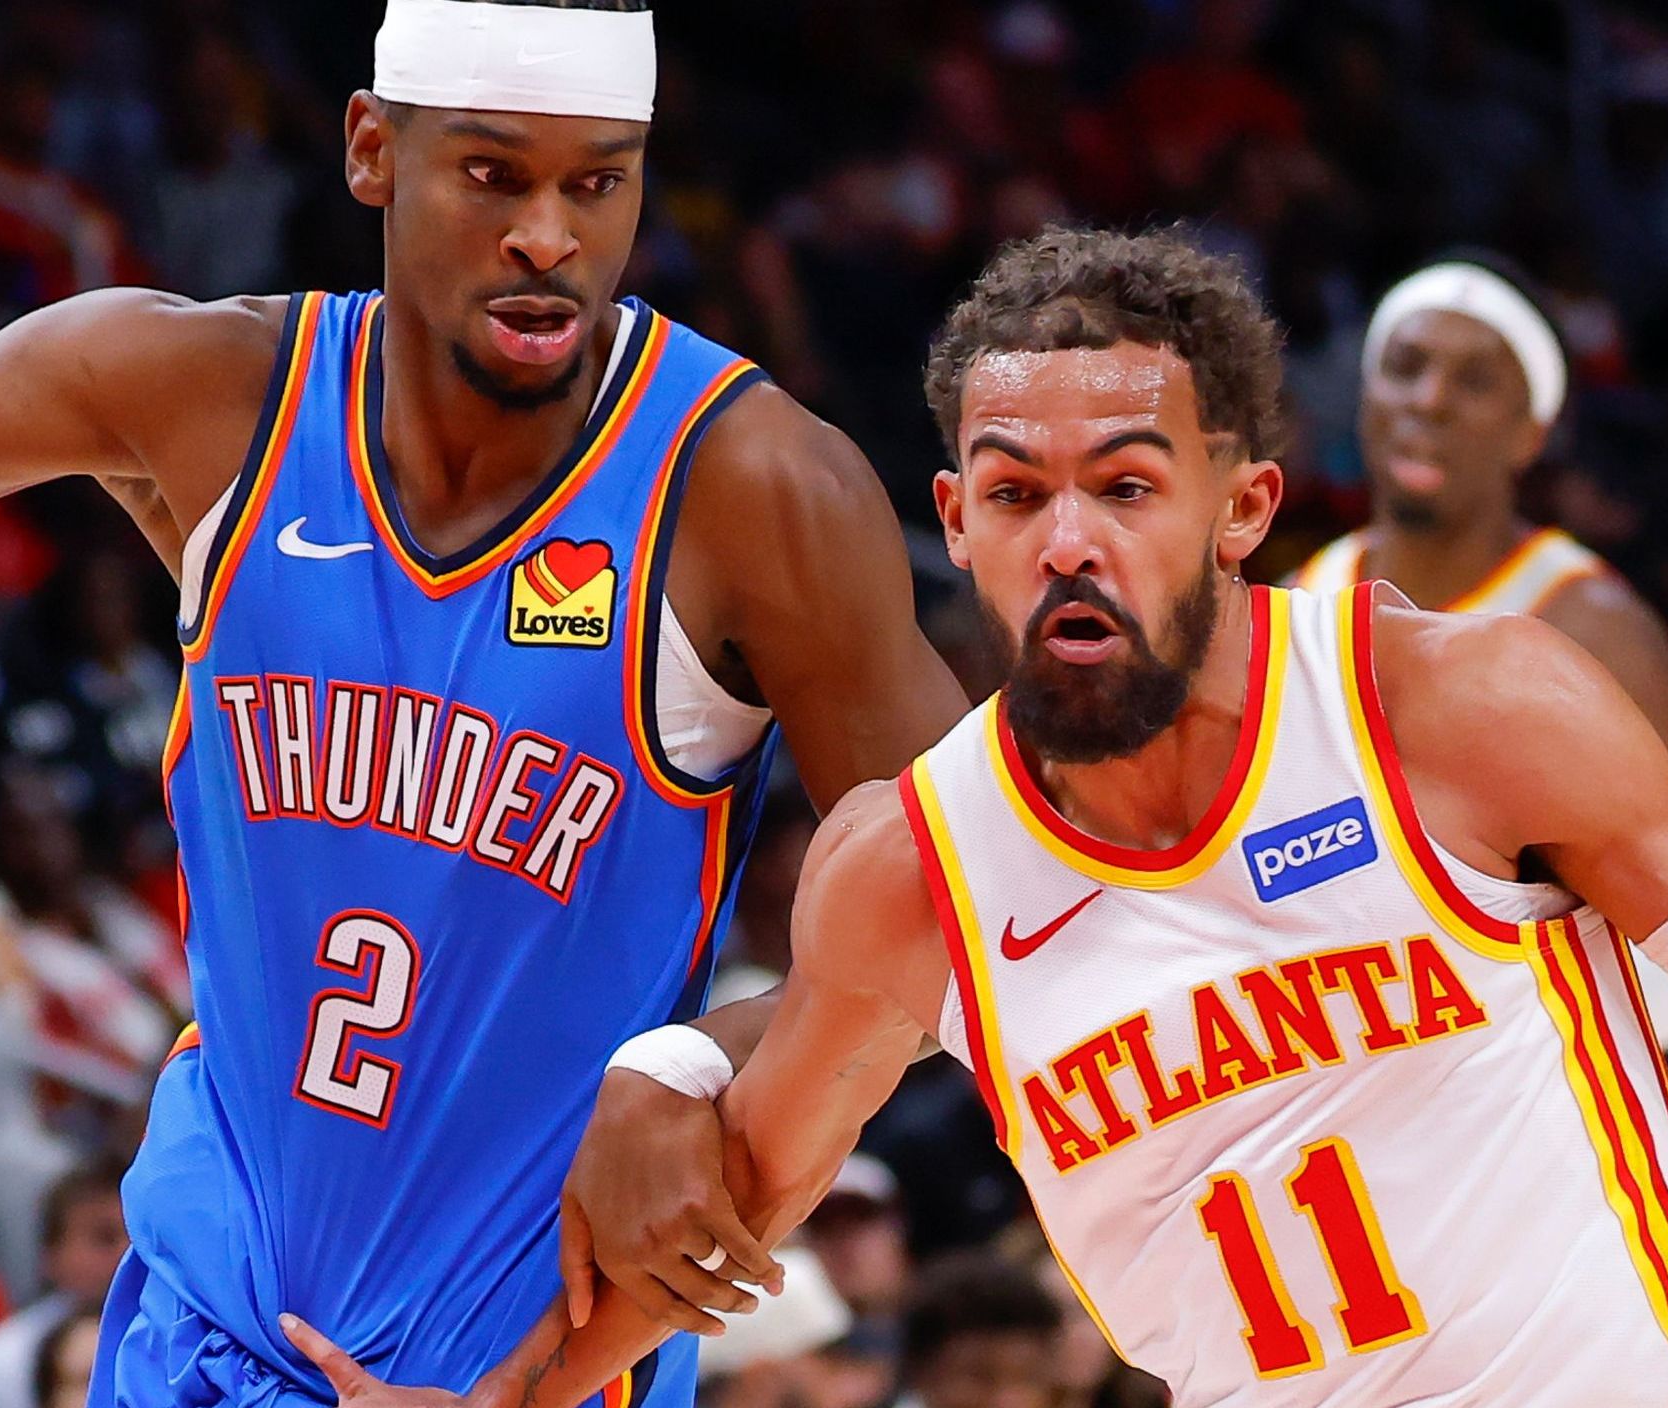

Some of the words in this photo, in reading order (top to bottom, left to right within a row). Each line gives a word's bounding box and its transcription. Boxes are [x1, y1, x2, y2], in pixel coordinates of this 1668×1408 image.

[214, 673, 625, 905] THUNDER
[1254, 815, 1364, 887] paze
[292, 908, 421, 1130] 2
[1020, 934, 1490, 1175] ATLANTA
[1195, 1136, 1429, 1380] 11
